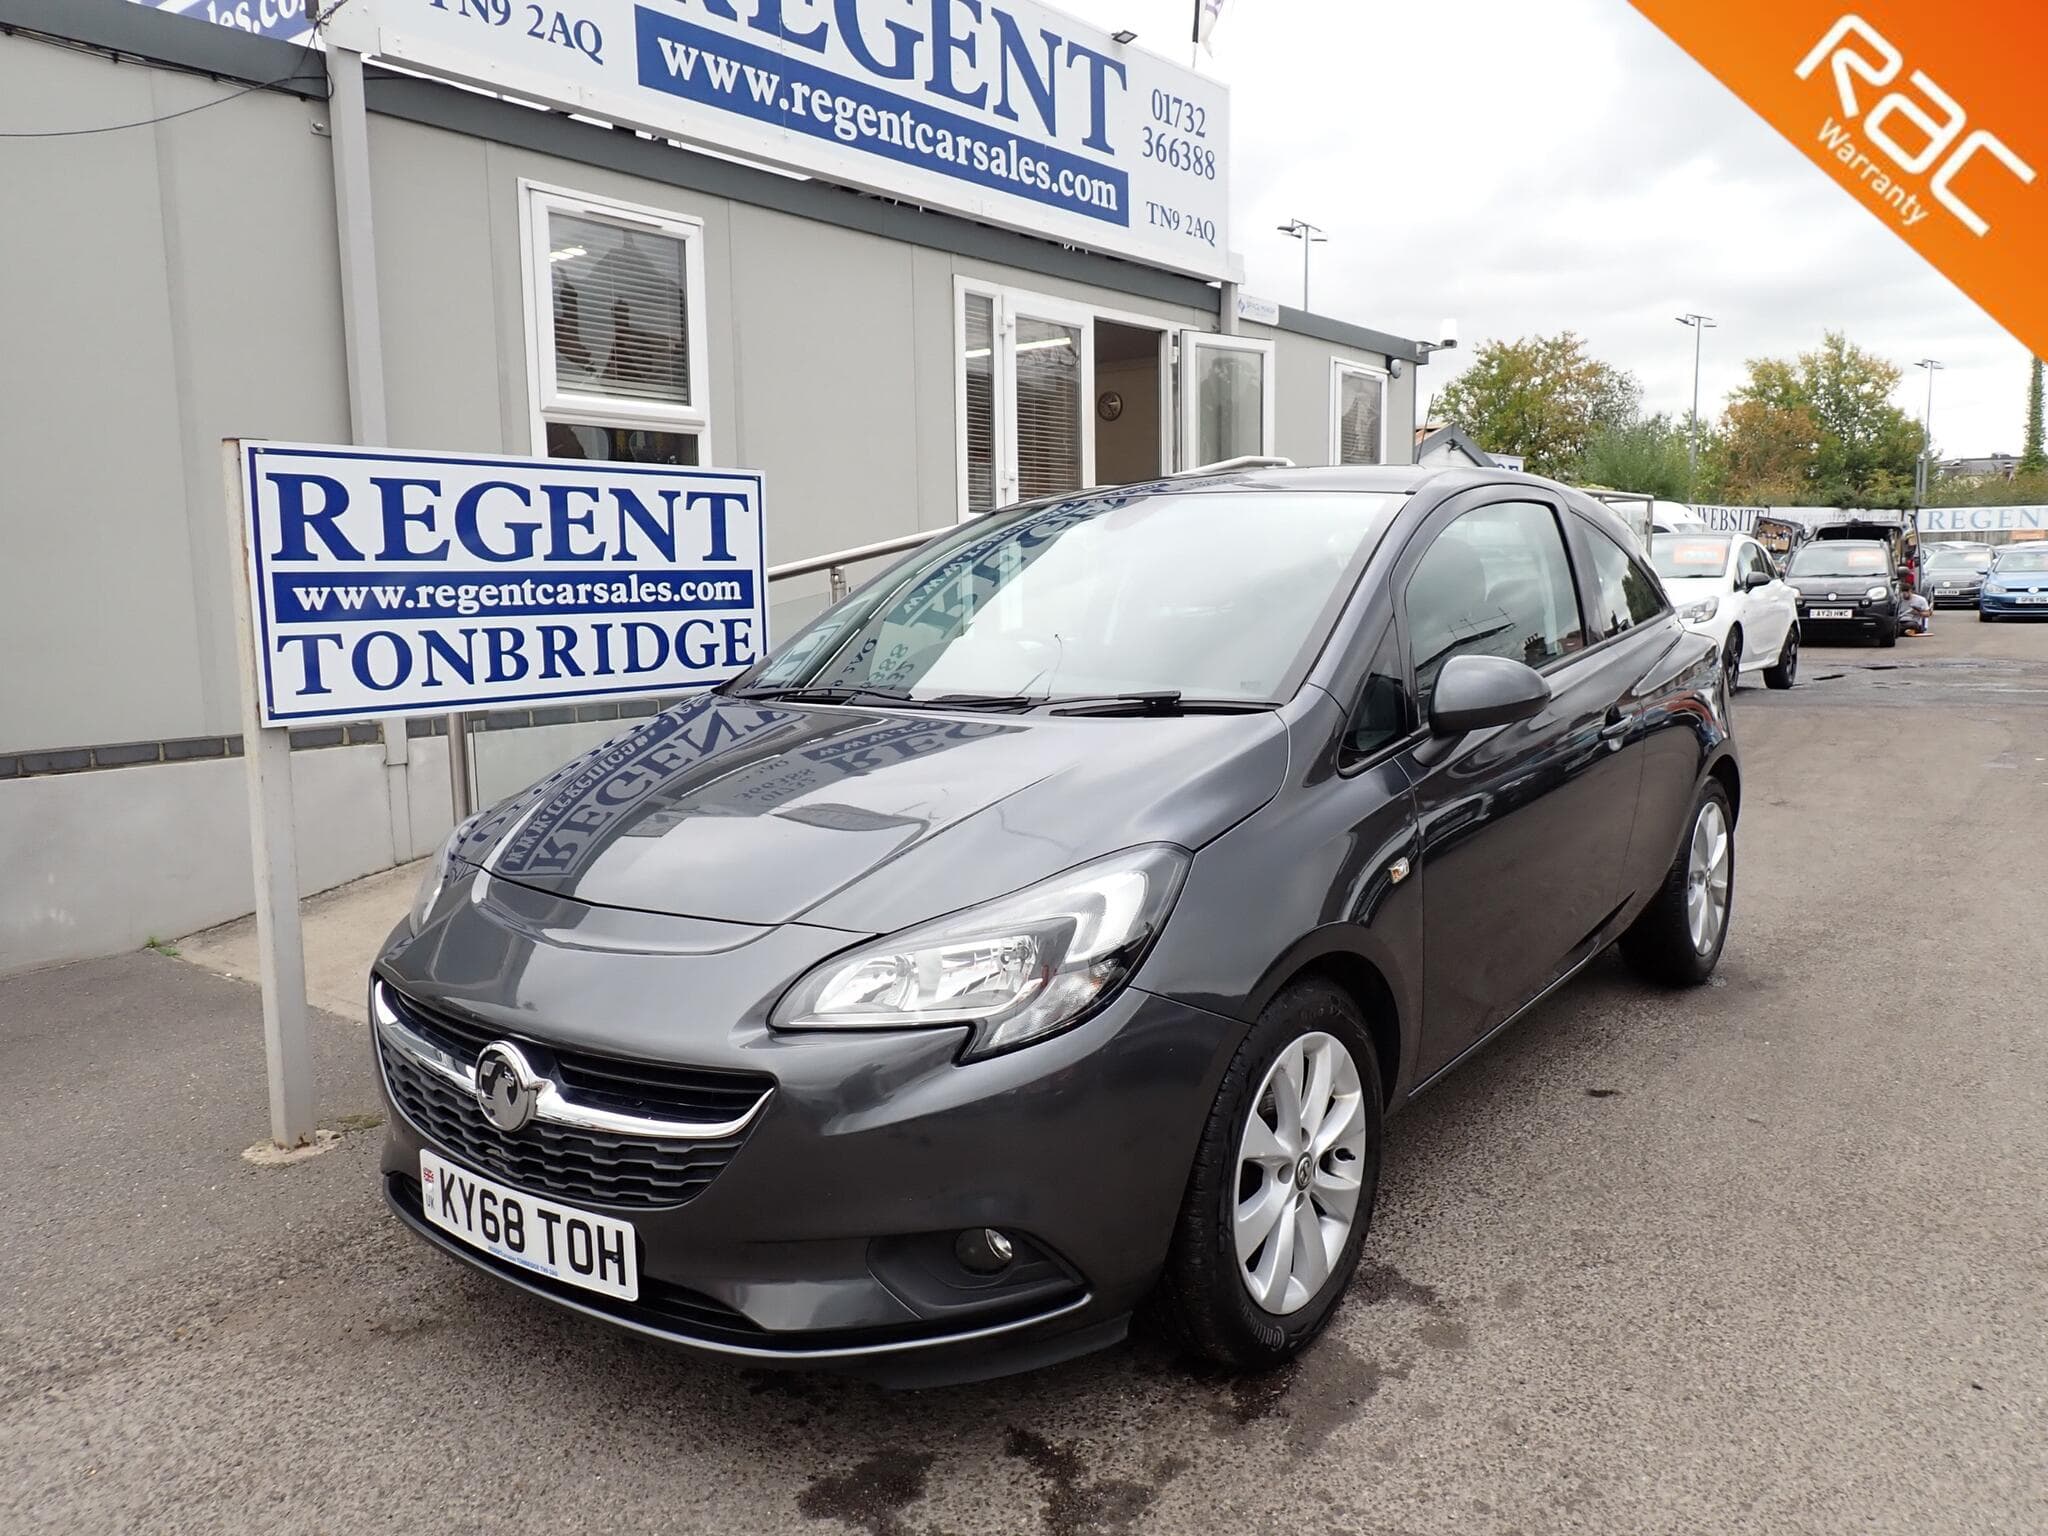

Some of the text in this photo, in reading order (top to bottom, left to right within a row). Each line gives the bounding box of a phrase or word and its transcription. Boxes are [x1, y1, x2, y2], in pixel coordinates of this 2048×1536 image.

[429, 0, 604, 65] N9 2AQ
[676, 0, 1127, 156] GENT
[658, 36, 1118, 212] www.regentcarsales.com
[1151, 88, 1206, 138] 01732
[1142, 126, 1216, 181] 366388
[1146, 200, 1217, 249] TN9 2AQ
[265, 472, 750, 564] REGENT
[1927, 508, 2048, 530] REGEN
[292, 573, 743, 615] www.regentcarsales.com
[277, 617, 757, 697] TONBRIDGE
[439, 1166, 626, 1286] KY68 TOH
